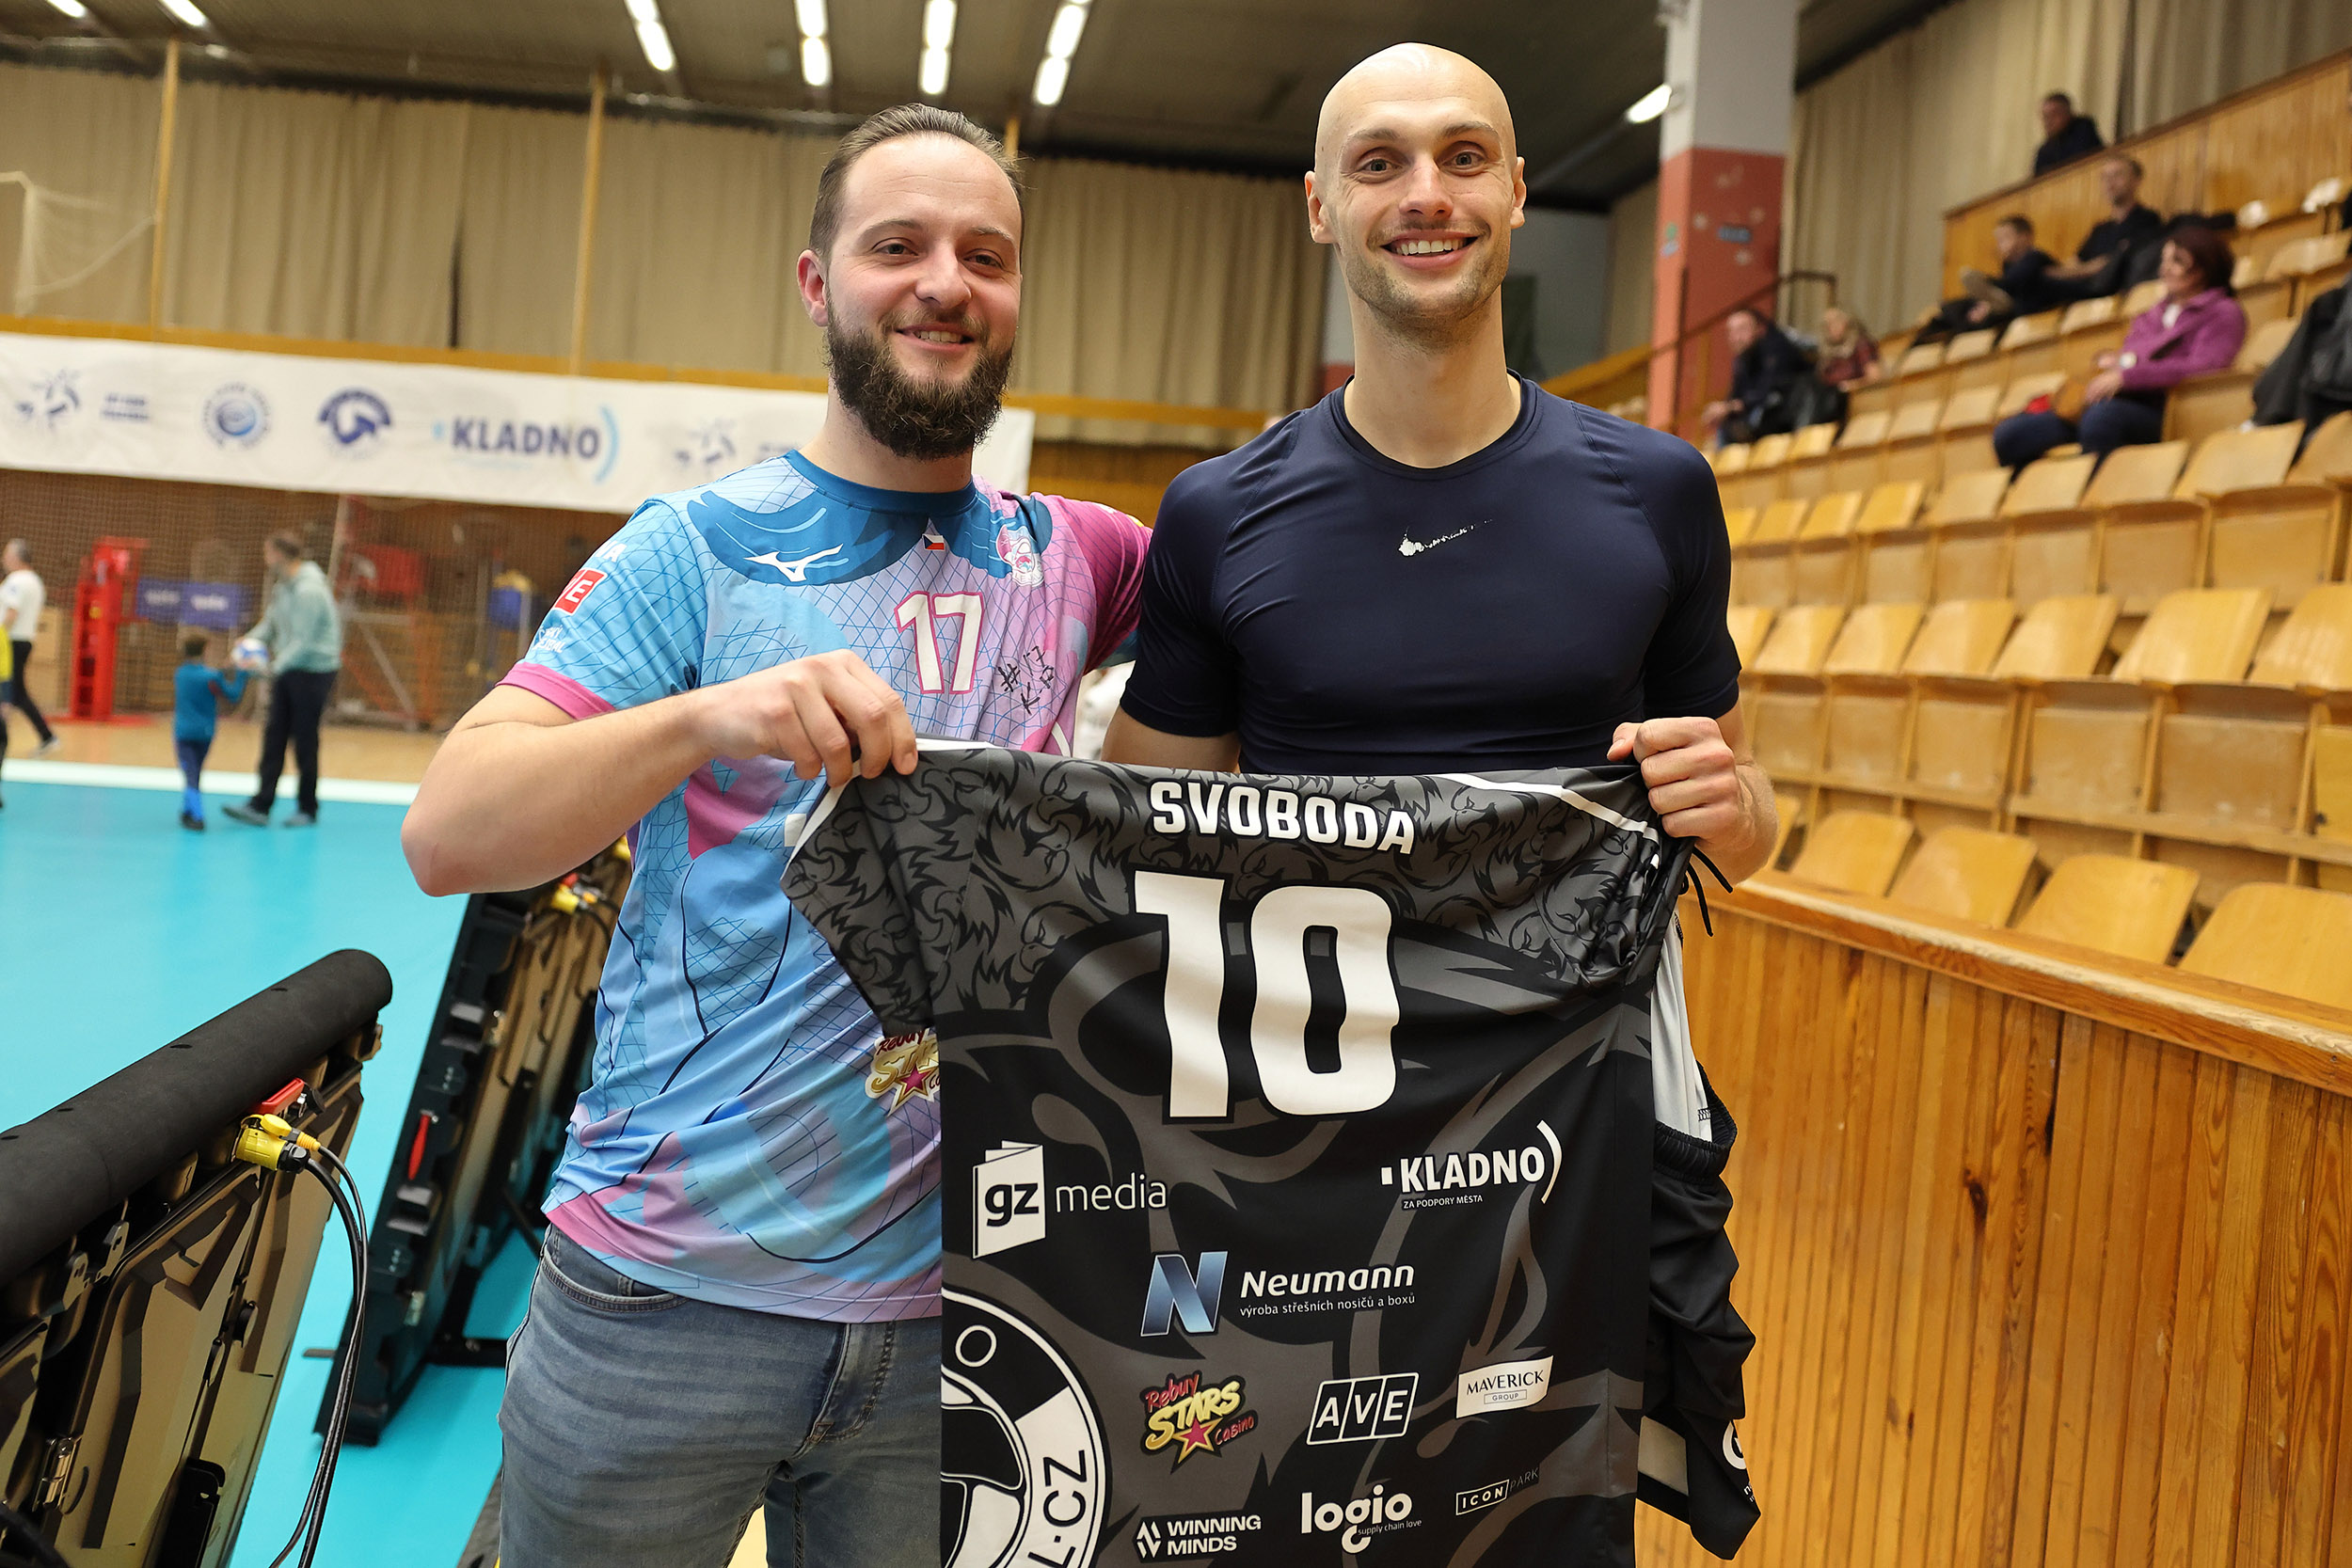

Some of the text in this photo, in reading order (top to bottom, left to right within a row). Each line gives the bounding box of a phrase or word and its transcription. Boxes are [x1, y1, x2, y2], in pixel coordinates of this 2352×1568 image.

[452, 417, 600, 460] KLADNO
[894, 590, 984, 695] 17
[1150, 781, 1415, 855] SVOBODA
[1134, 869, 1401, 1117] 10
[1400, 1146, 1546, 1194] KLADNO
[984, 1172, 1167, 1227] gz media
[1403, 1194, 1484, 1210] ZA PODPORY MĚSTA
[1239, 1264, 1415, 1299] Neumann
[1239, 1291, 1416, 1317] výroba střešních nosičů a boxů
[1145, 1373, 1200, 1414] Rebuy
[1466, 1369, 1545, 1396] MAVERICK
[1491, 1392, 1519, 1402] GROUP
[1145, 1380, 1241, 1450] STARS
[1315, 1388, 1409, 1429] AVE
[1462, 1486, 1504, 1509] ICON
[1510, 1467, 1539, 1492] PARK
[1167, 1514, 1263, 1537] WINNING
[1300, 1483, 1413, 1554] logio
[1358, 1518, 1422, 1536] supply chain love
[1167, 1535, 1238, 1556] MINDS
